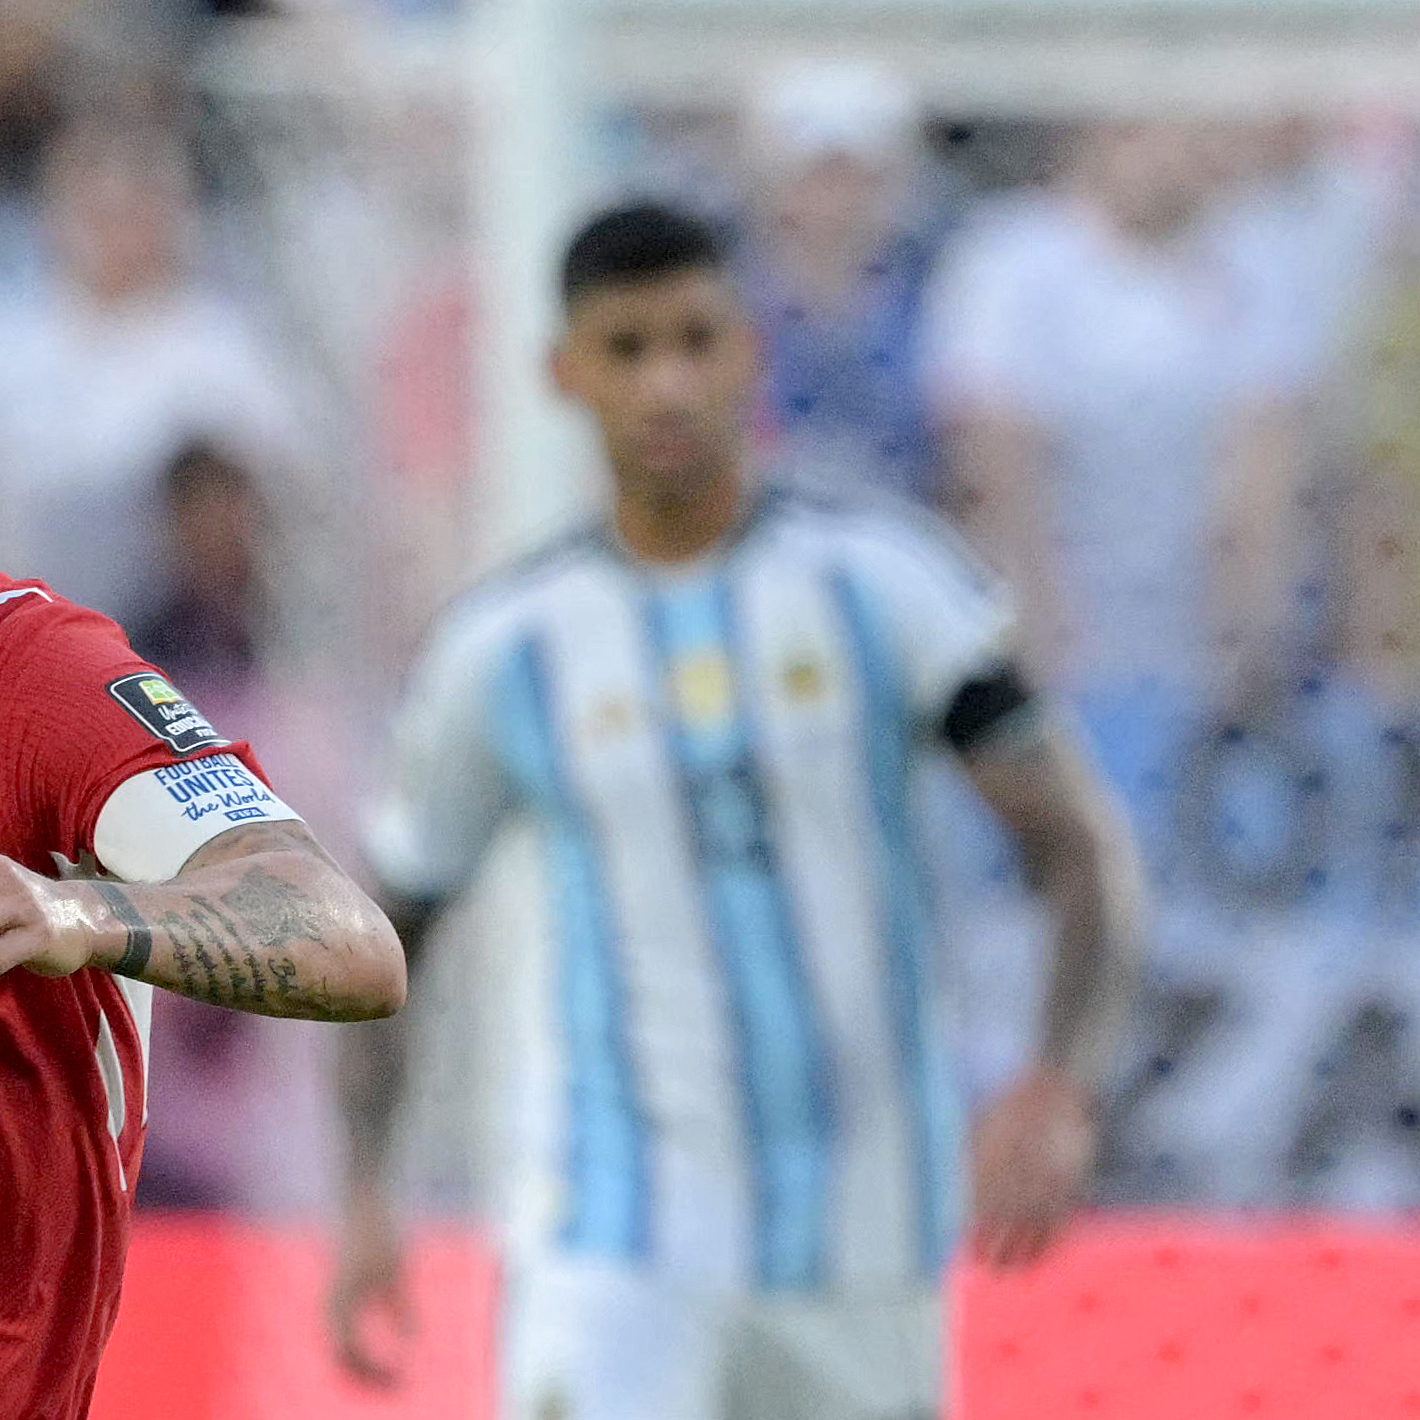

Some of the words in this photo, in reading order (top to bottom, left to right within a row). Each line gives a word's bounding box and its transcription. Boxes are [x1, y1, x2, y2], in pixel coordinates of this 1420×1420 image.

[154, 754, 239, 786] FOOTBALL
[166, 769, 254, 803] UNITES
[181, 801, 220, 821] the
[215, 788, 275, 808] World
